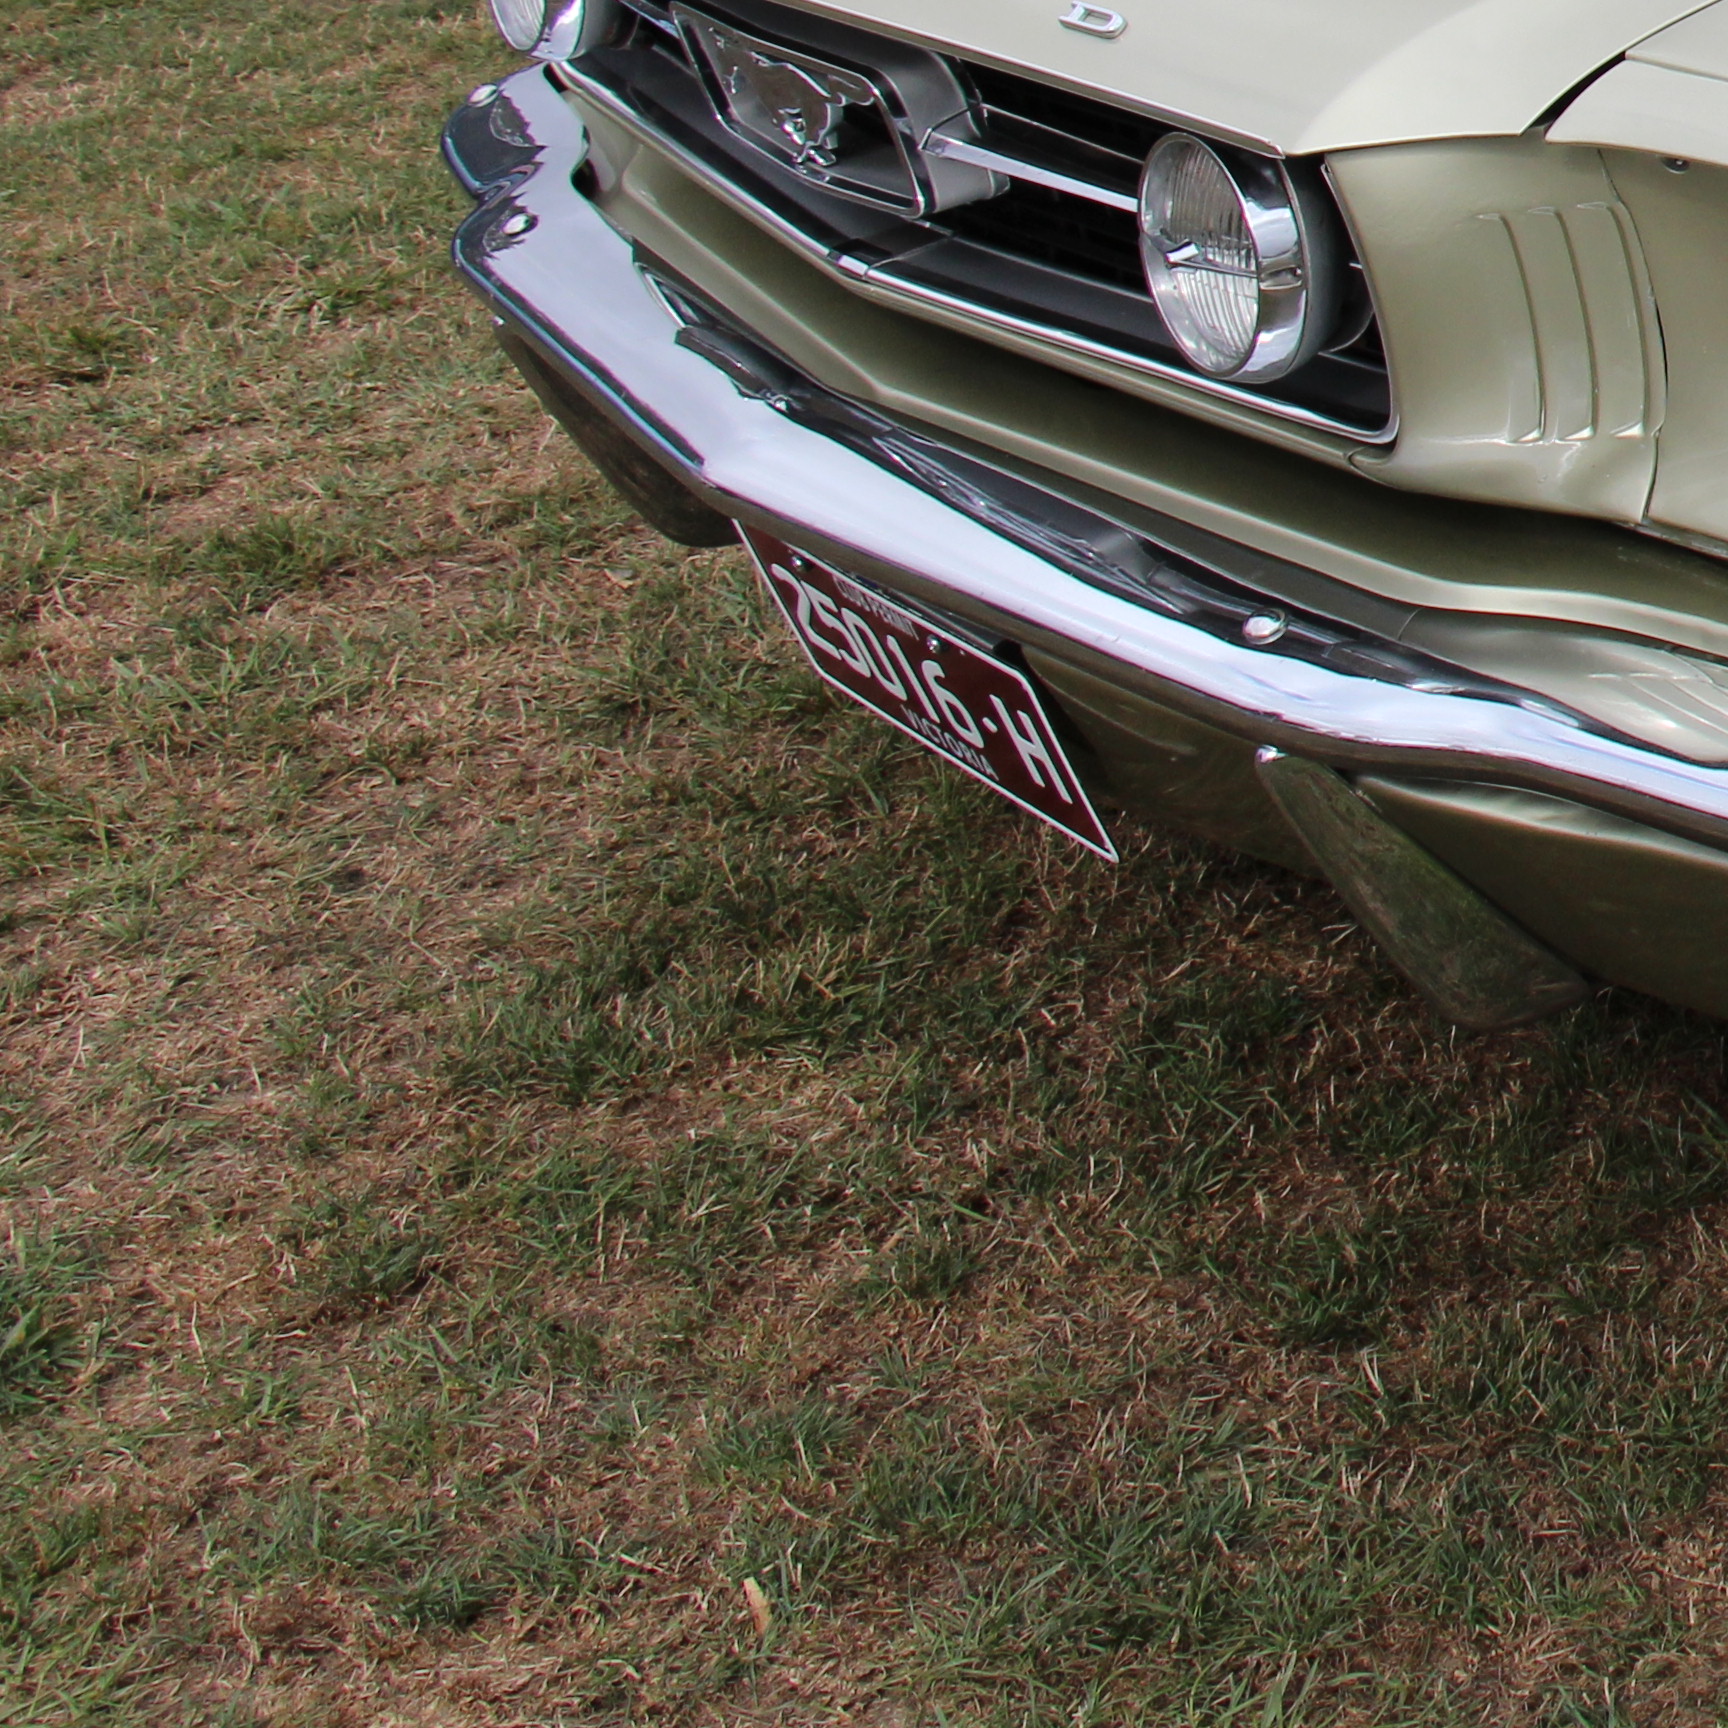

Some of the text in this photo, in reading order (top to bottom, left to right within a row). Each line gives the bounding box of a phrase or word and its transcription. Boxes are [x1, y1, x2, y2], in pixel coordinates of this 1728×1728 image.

[832, 575, 920, 642] CLUB PERMIT
[898, 701, 1001, 783] VICTORIA
